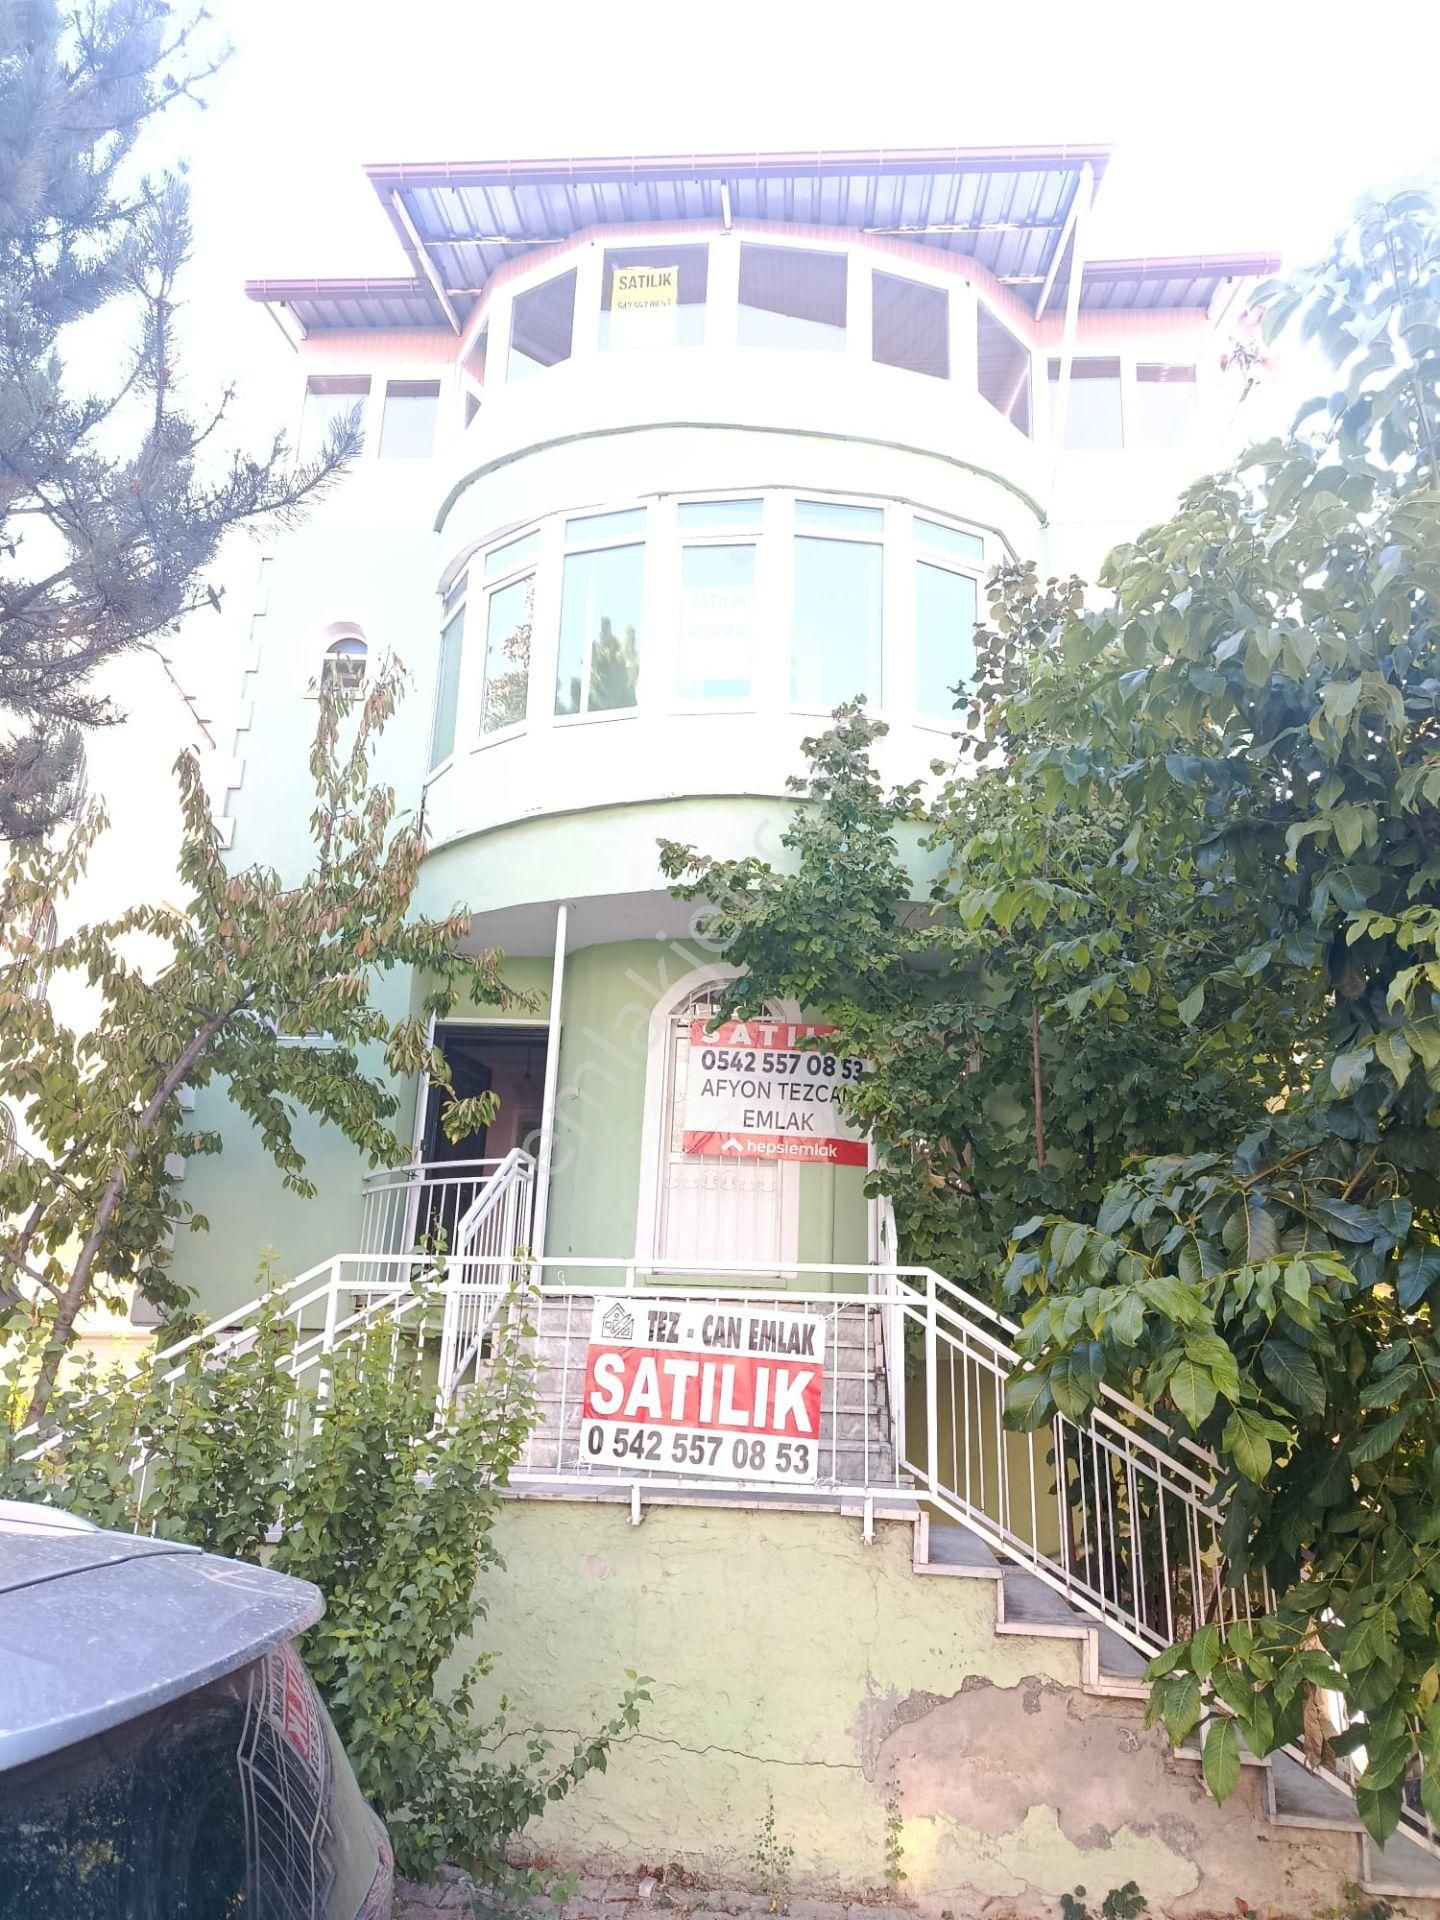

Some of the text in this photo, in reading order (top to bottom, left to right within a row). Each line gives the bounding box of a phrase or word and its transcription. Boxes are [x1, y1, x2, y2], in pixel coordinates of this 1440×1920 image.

[618, 272, 672, 290] SATILIK
[701, 1049, 864, 1081] 0542 557 08 53
[701, 1078, 771, 1100] AFYON
[743, 1109, 815, 1132] EMLAK
[746, 1139, 838, 1159] hepsiemlak
[647, 1310, 682, 1344] TEZ
[702, 1314, 743, 1349] CAN
[748, 1318, 816, 1356] EMLAK
[590, 1352, 815, 1433] SATILIK
[587, 1425, 809, 1475] 0 542 557 08 53
